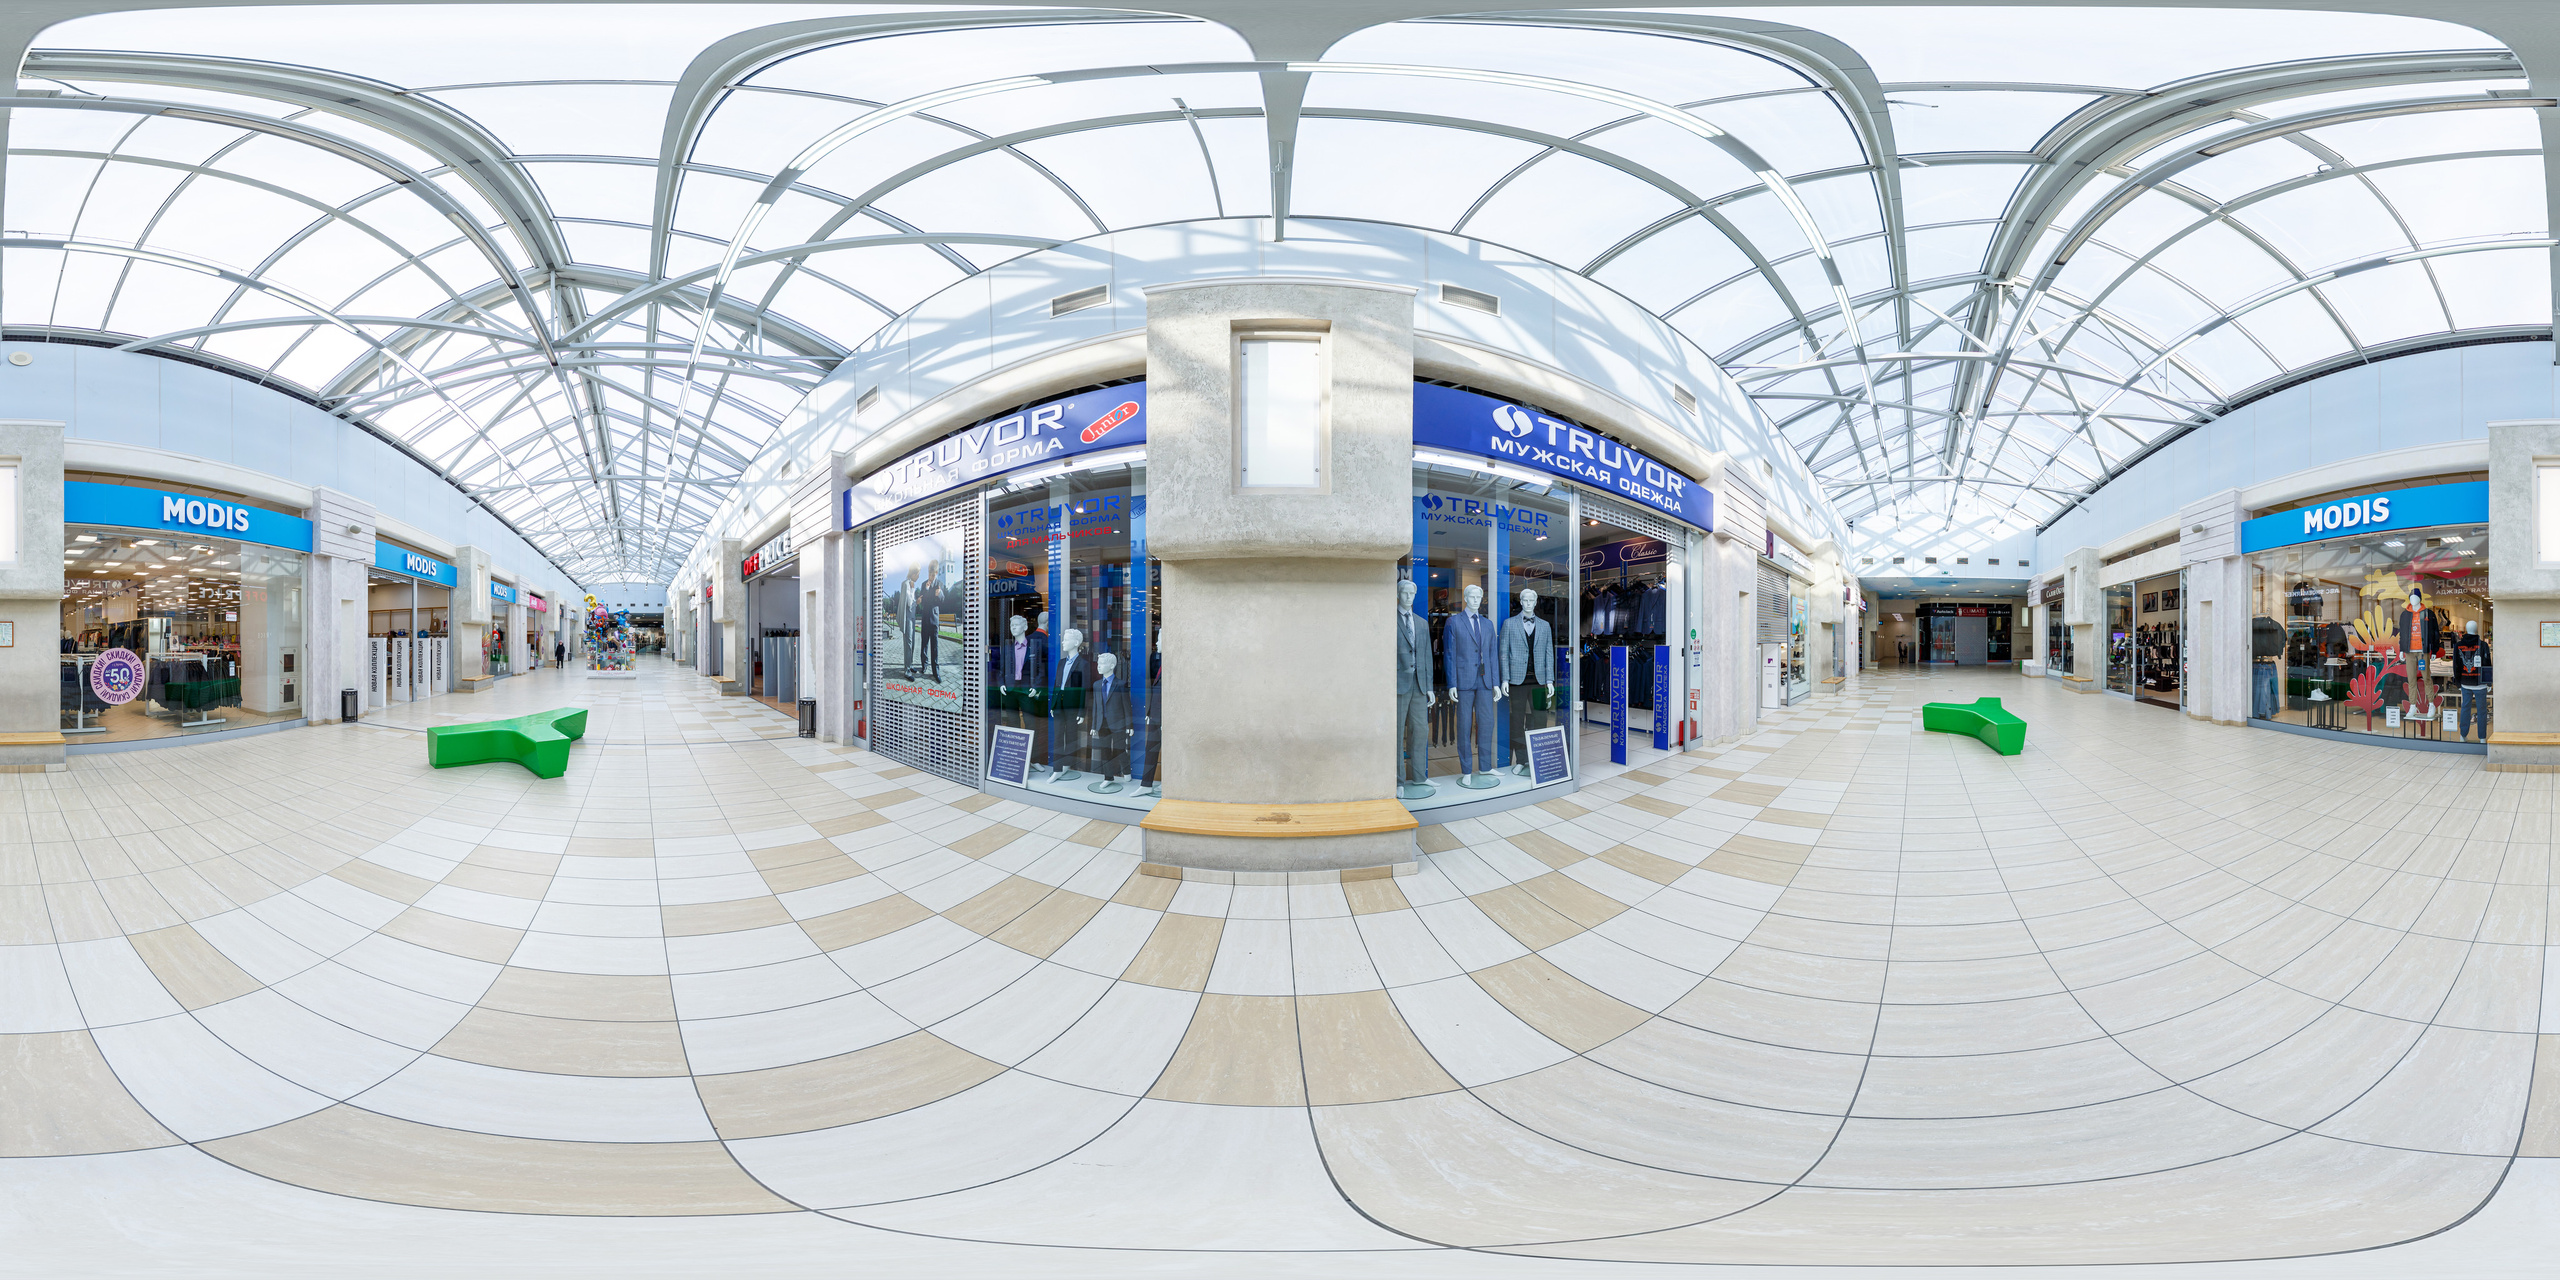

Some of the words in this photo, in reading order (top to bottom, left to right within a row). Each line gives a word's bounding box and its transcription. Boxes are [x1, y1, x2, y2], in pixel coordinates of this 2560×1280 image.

[1087, 406, 1129, 439] Junior
[896, 404, 1065, 484] TRUVOR
[971, 437, 1065, 472] ФОРМА
[1538, 417, 1683, 497] TRUVOR
[1491, 436, 1611, 484] МУЖСКАЯ
[1620, 478, 1682, 513] ОДЕЖДА
[162, 496, 250, 532] MODIS
[1016, 496, 1120, 524] TRUVOR
[1421, 512, 1492, 528] МУЖСКАЯ
[1498, 522, 1547, 537] ОДЕЖДА
[1446, 497, 1548, 528] TRUVOR
[2304, 497, 2390, 534] MODIS
[997, 522, 1061, 539] ШКОЛЬНАЯ
[1070, 513, 1120, 526] ФОРМА
[1007, 537, 1029, 549] ДЛЯ
[1032, 527, 1112, 544] МАЛЬЧИКОВ
[407, 553, 437, 576] MODIS
[1580, 556, 1595, 567] lassic
[1631, 543, 1657, 560] Classic
[106, 651, 136, 664] СКИДКИ!
[93, 658, 107, 690] СКИДКИ!
[133, 663, 143, 694] СКИДКИ!
[100, 689, 131, 702] СКИДКИ!
[886, 683, 922, 695] ШКОЛЬНАЯ
[927, 688, 957, 700] ФОРМА
[1612, 667, 1620, 730] TRUVOR
